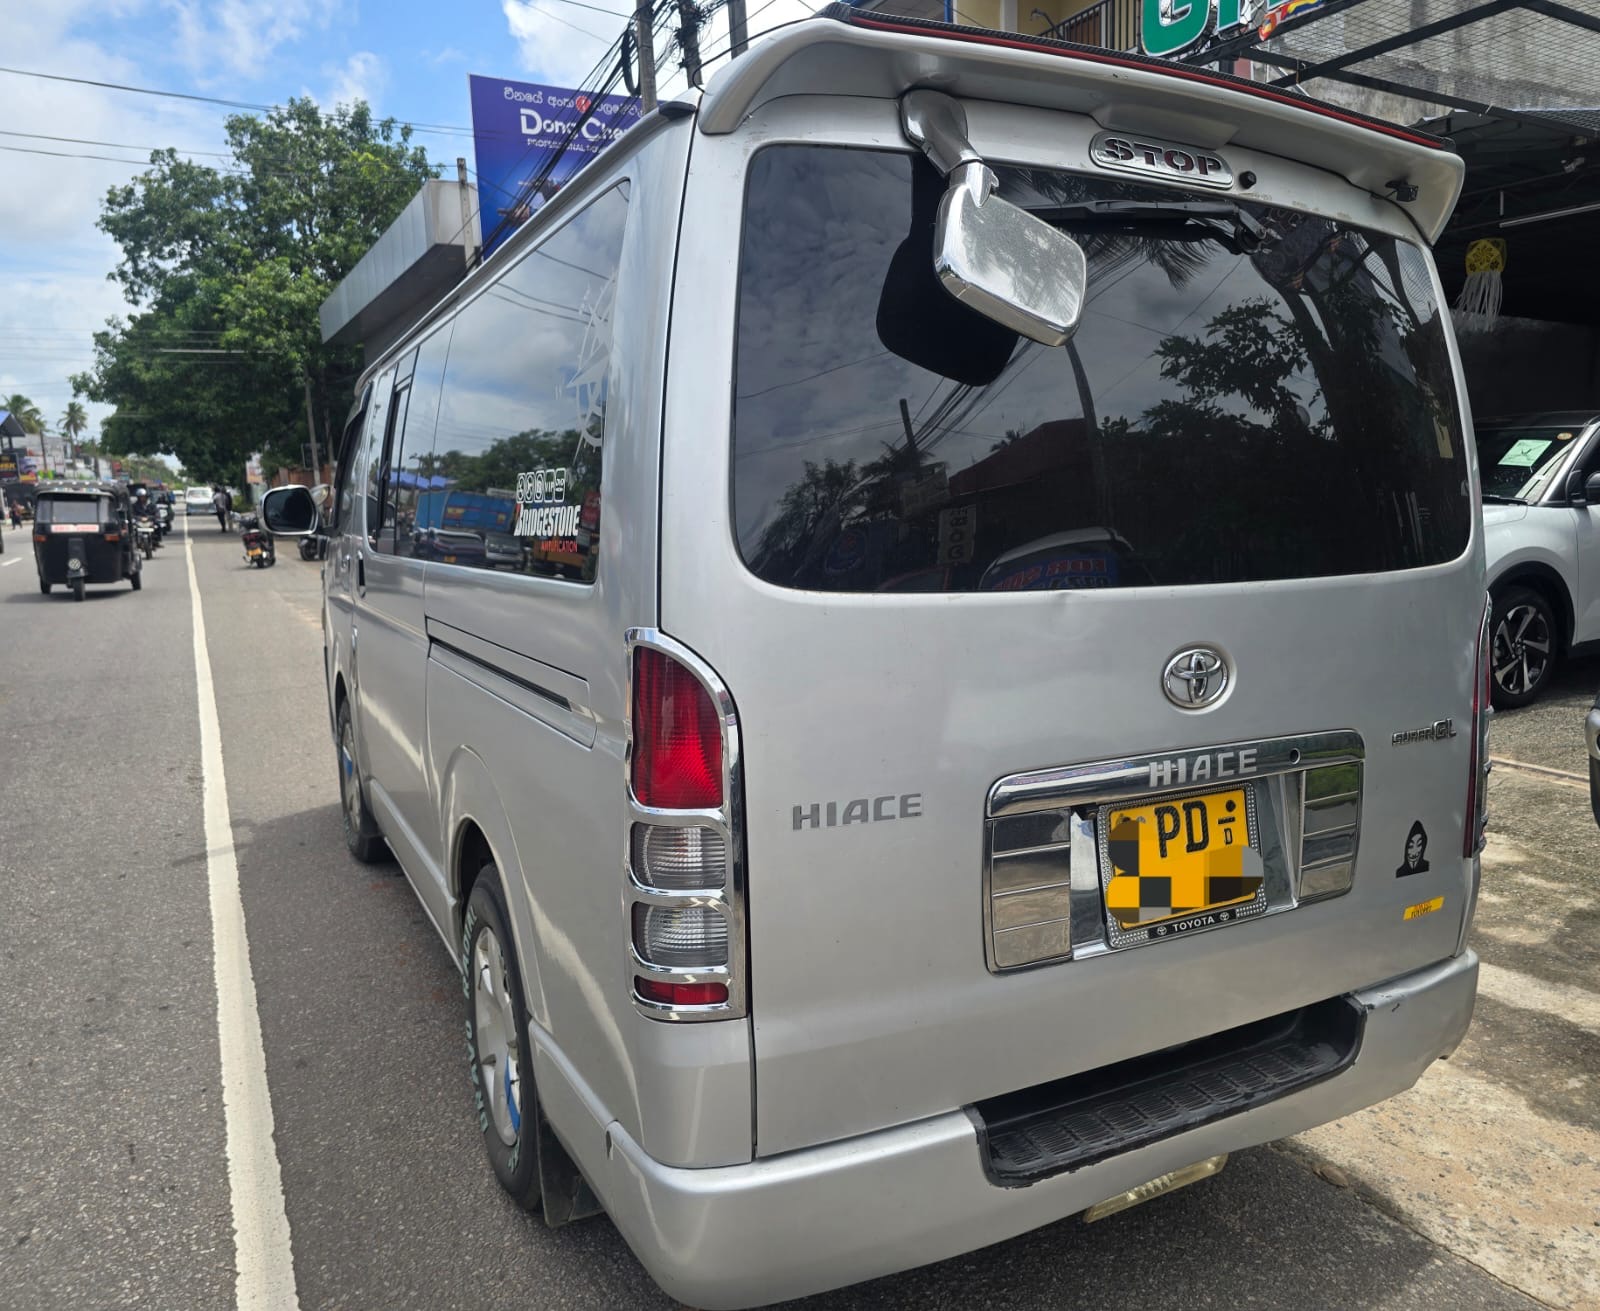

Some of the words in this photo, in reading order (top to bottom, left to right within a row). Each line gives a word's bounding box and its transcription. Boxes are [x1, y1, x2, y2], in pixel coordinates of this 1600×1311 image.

[1103, 137, 1222, 176] STOP
[513, 503, 582, 537] BRIDGESTONE
[1149, 748, 1258, 788] HIACE
[792, 793, 922, 831] HIACE
[1172, 915, 1215, 932] TOYOTA
